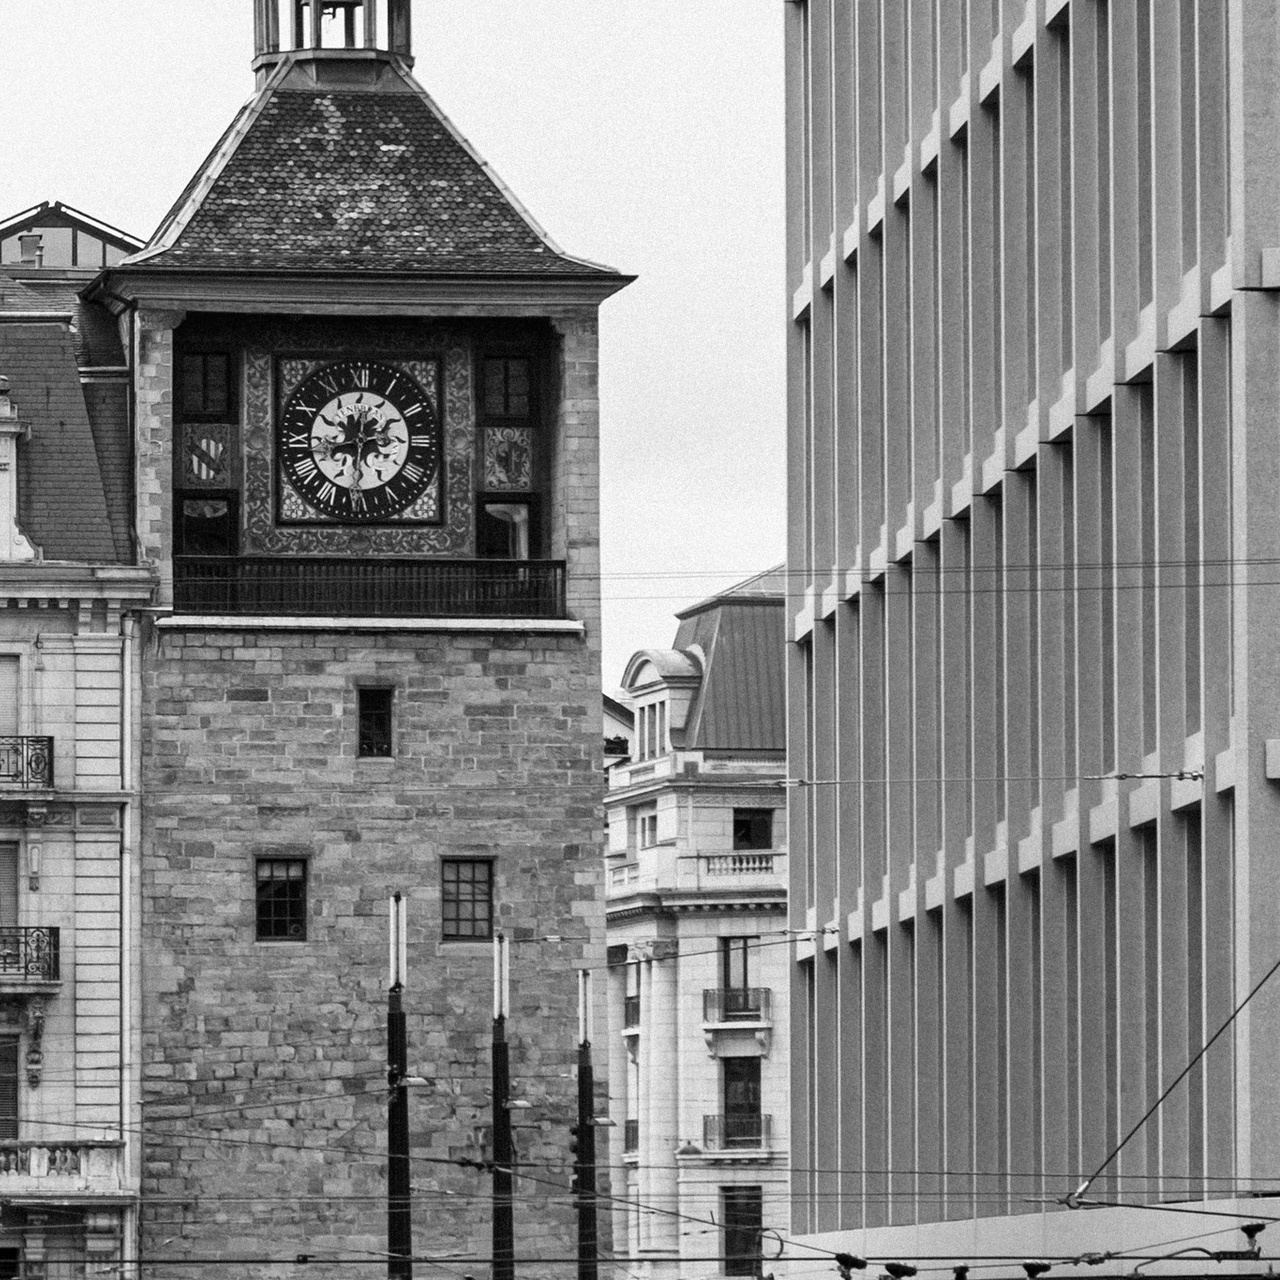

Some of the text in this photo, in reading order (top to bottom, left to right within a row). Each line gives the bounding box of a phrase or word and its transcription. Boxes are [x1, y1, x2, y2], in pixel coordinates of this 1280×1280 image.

[349, 369, 369, 388] XII
[385, 378, 396, 396] I
[295, 399, 317, 418] X
[403, 402, 422, 418] II
[288, 432, 309, 448] IX
[411, 435, 430, 447] III
[293, 458, 319, 485] VIII
[401, 461, 425, 483] IIII
[316, 481, 337, 506] VII
[384, 486, 399, 505] V
